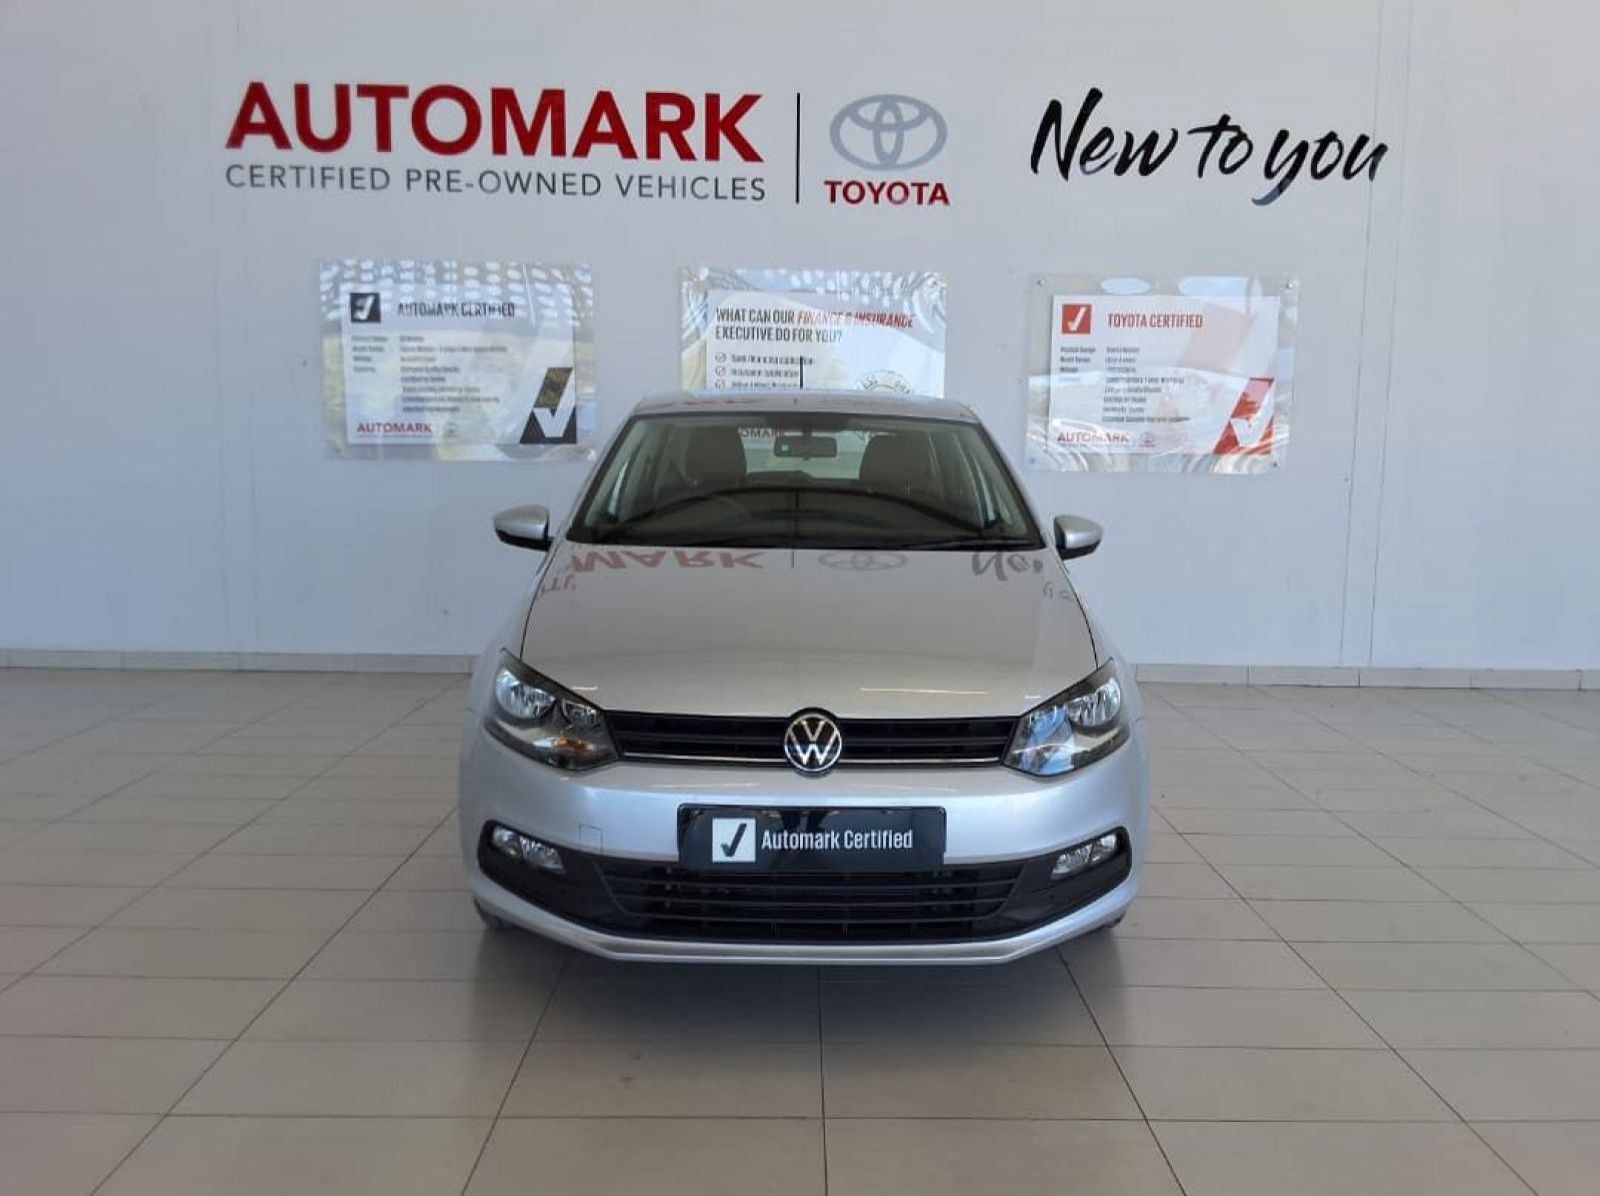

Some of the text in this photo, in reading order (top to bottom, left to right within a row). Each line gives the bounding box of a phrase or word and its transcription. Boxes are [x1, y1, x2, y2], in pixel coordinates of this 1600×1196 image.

[225, 81, 764, 162] AUTOMARK
[1030, 87, 1388, 206] New to you
[225, 164, 766, 201] CERTIFIED PRE-OWNED VEHICLES
[824, 179, 950, 206] TOYOTA
[716, 308, 747, 323] WHAT
[749, 309, 774, 324] CAN
[776, 309, 795, 324] OUR
[1107, 313, 1204, 328] TOYOTA CERTIFIED
[715, 326, 842, 343] EXECUTIVE DO FOR YOU?
[357, 422, 432, 434] AUTOMARK
[1057, 431, 1129, 443] AUTOARK
[761, 829, 914, 850] Automark Certified
